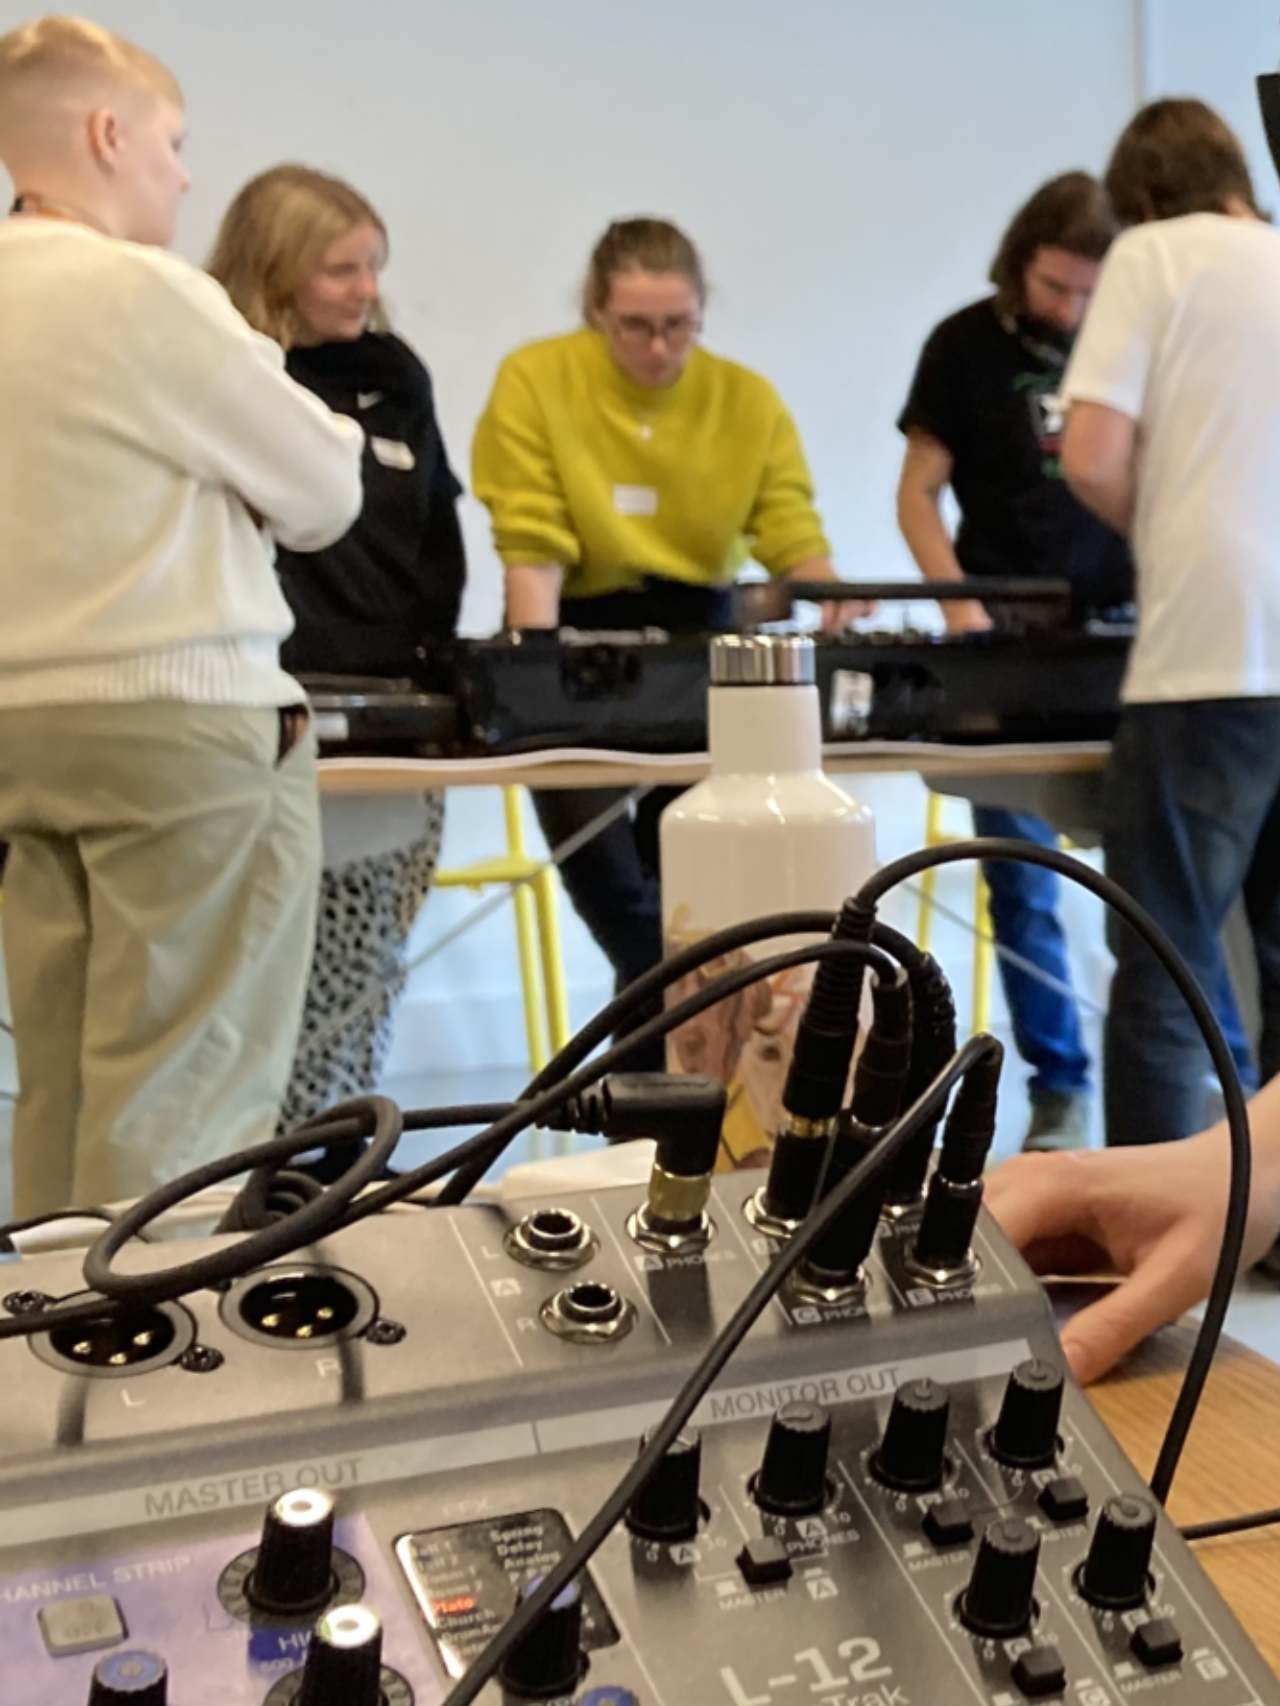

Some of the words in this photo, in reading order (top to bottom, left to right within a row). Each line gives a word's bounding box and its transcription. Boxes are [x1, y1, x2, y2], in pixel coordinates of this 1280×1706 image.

[481, 1245, 499, 1259] L
[516, 1317, 537, 1333] R
[315, 1357, 342, 1378] R
[121, 1388, 147, 1408] L
[710, 1377, 840, 1420] MONITOR
[846, 1367, 899, 1395] OUT
[144, 1470, 284, 1517] MASTER
[295, 1458, 362, 1490] OUT
[497, 1541, 542, 1556] Delay
[112, 1555, 191, 1583] STRIP
[719, 1588, 788, 1610] MASTER
[720, 1636, 893, 1706] L-12
